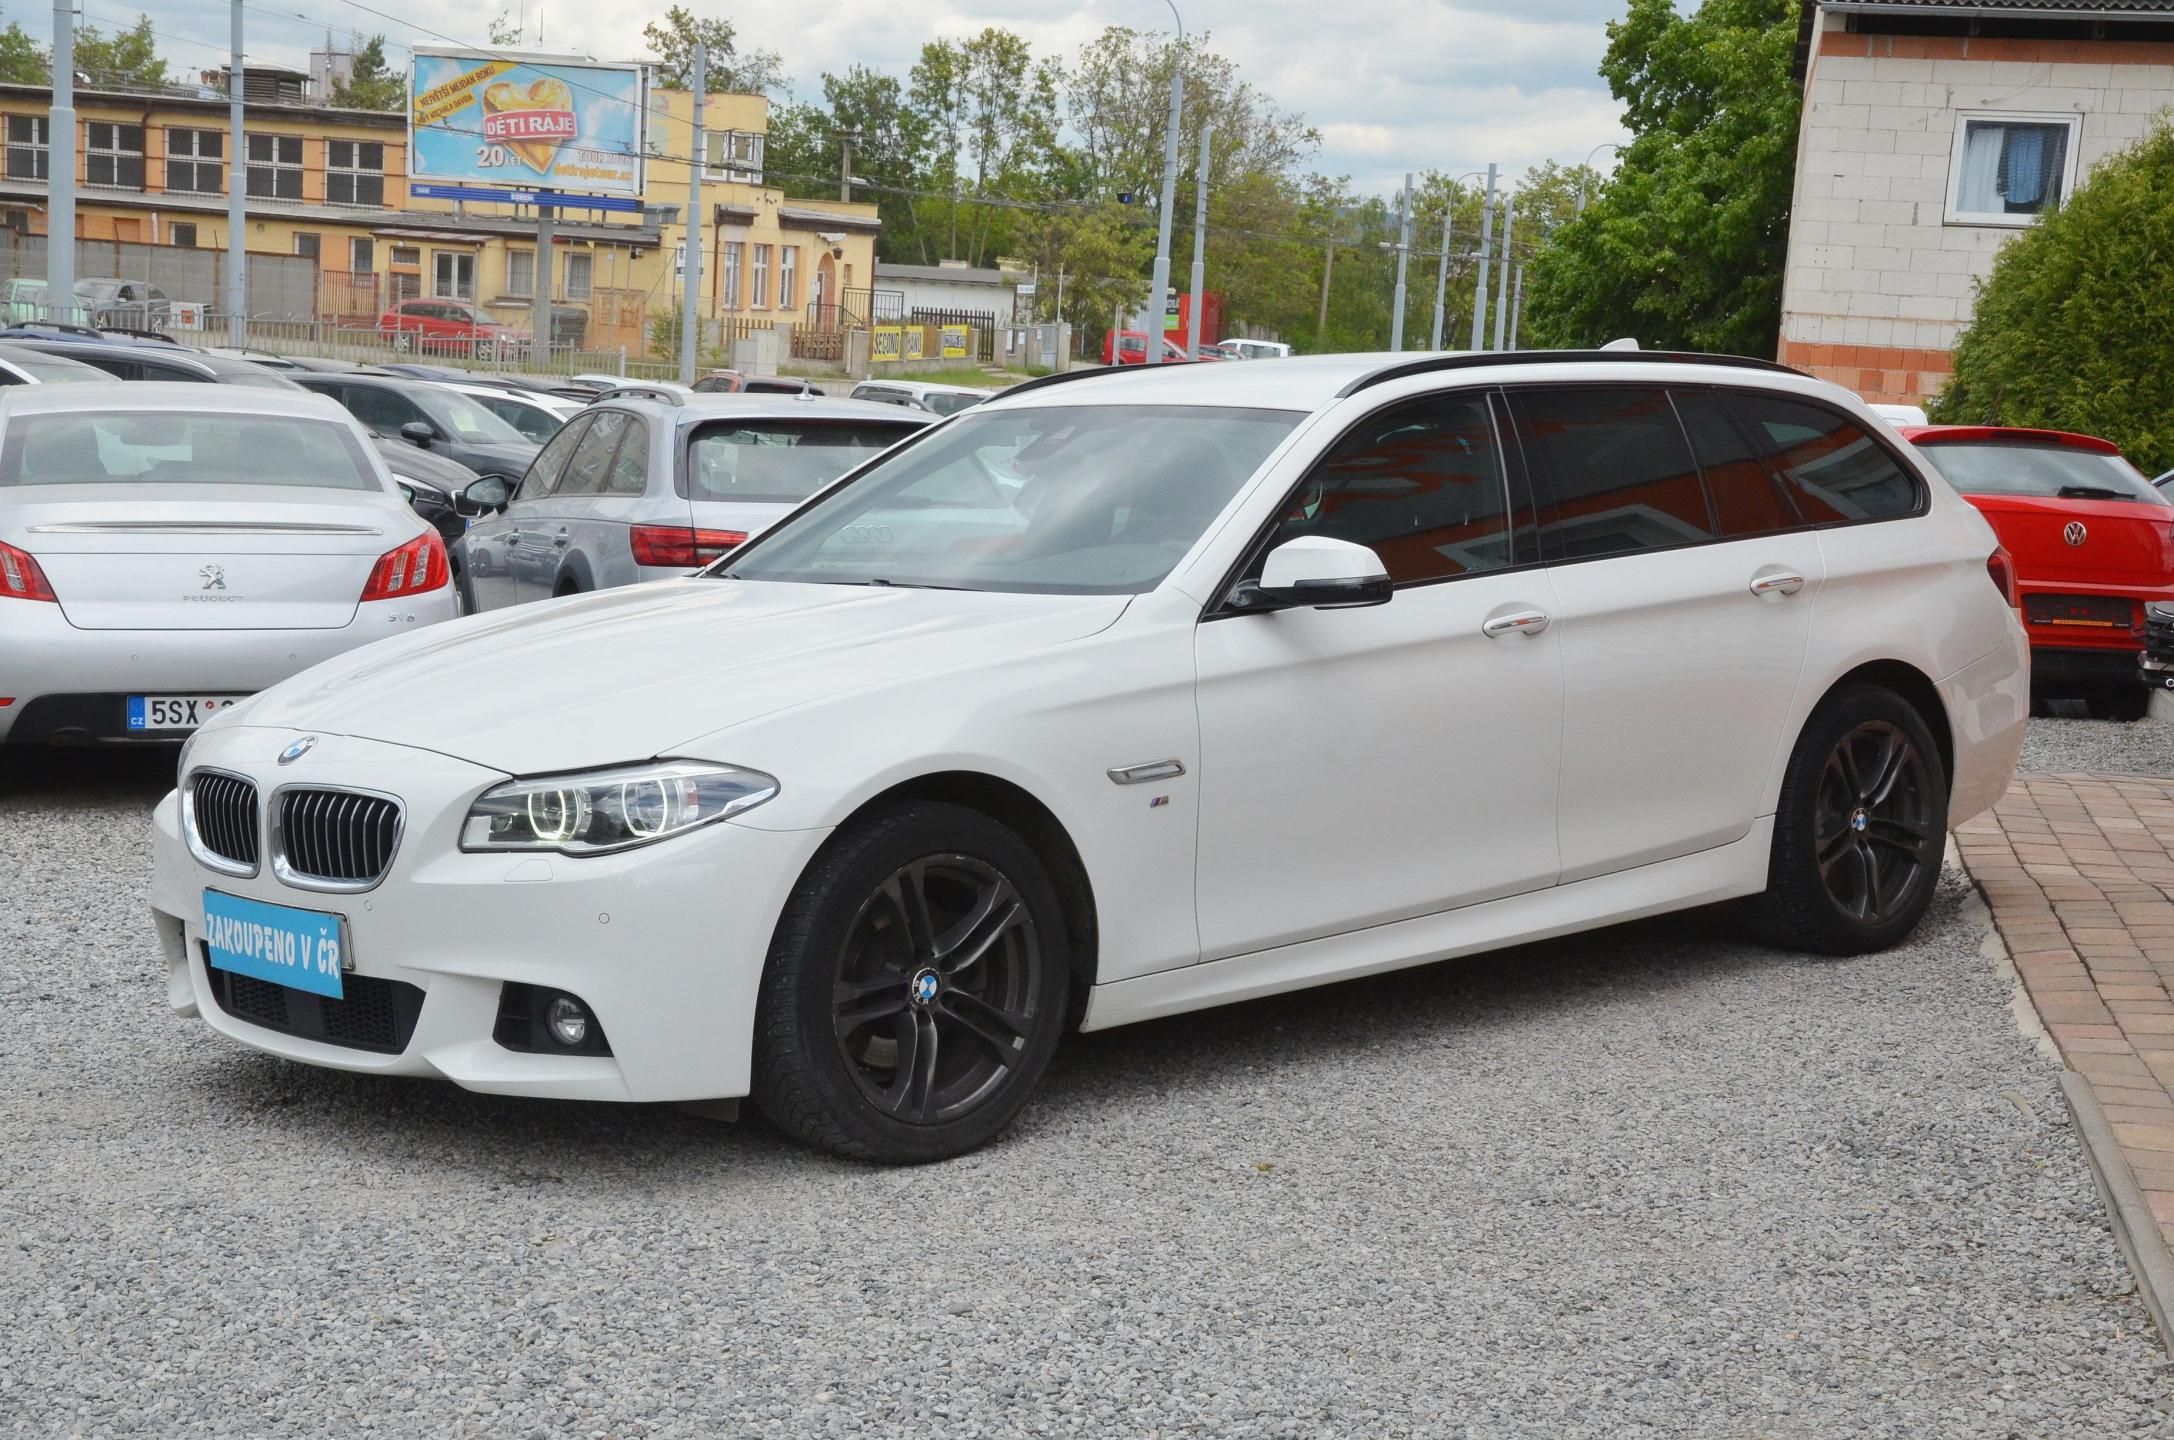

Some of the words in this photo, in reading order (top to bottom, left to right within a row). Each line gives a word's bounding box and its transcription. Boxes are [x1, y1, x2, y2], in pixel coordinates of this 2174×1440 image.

[475, 65, 496, 81] ROKU
[487, 117, 525, 135] DĚTI
[529, 113, 573, 132] RÁJE
[477, 145, 505, 168] 20
[577, 150, 604, 163] TOUR
[874, 332, 900, 355] SECOND
[130, 717, 144, 725] CZ
[152, 700, 199, 724] 5SX
[206, 913, 296, 967] ZAKOUPENO
[301, 933, 312, 970] V
[317, 927, 339, 980] ČR
